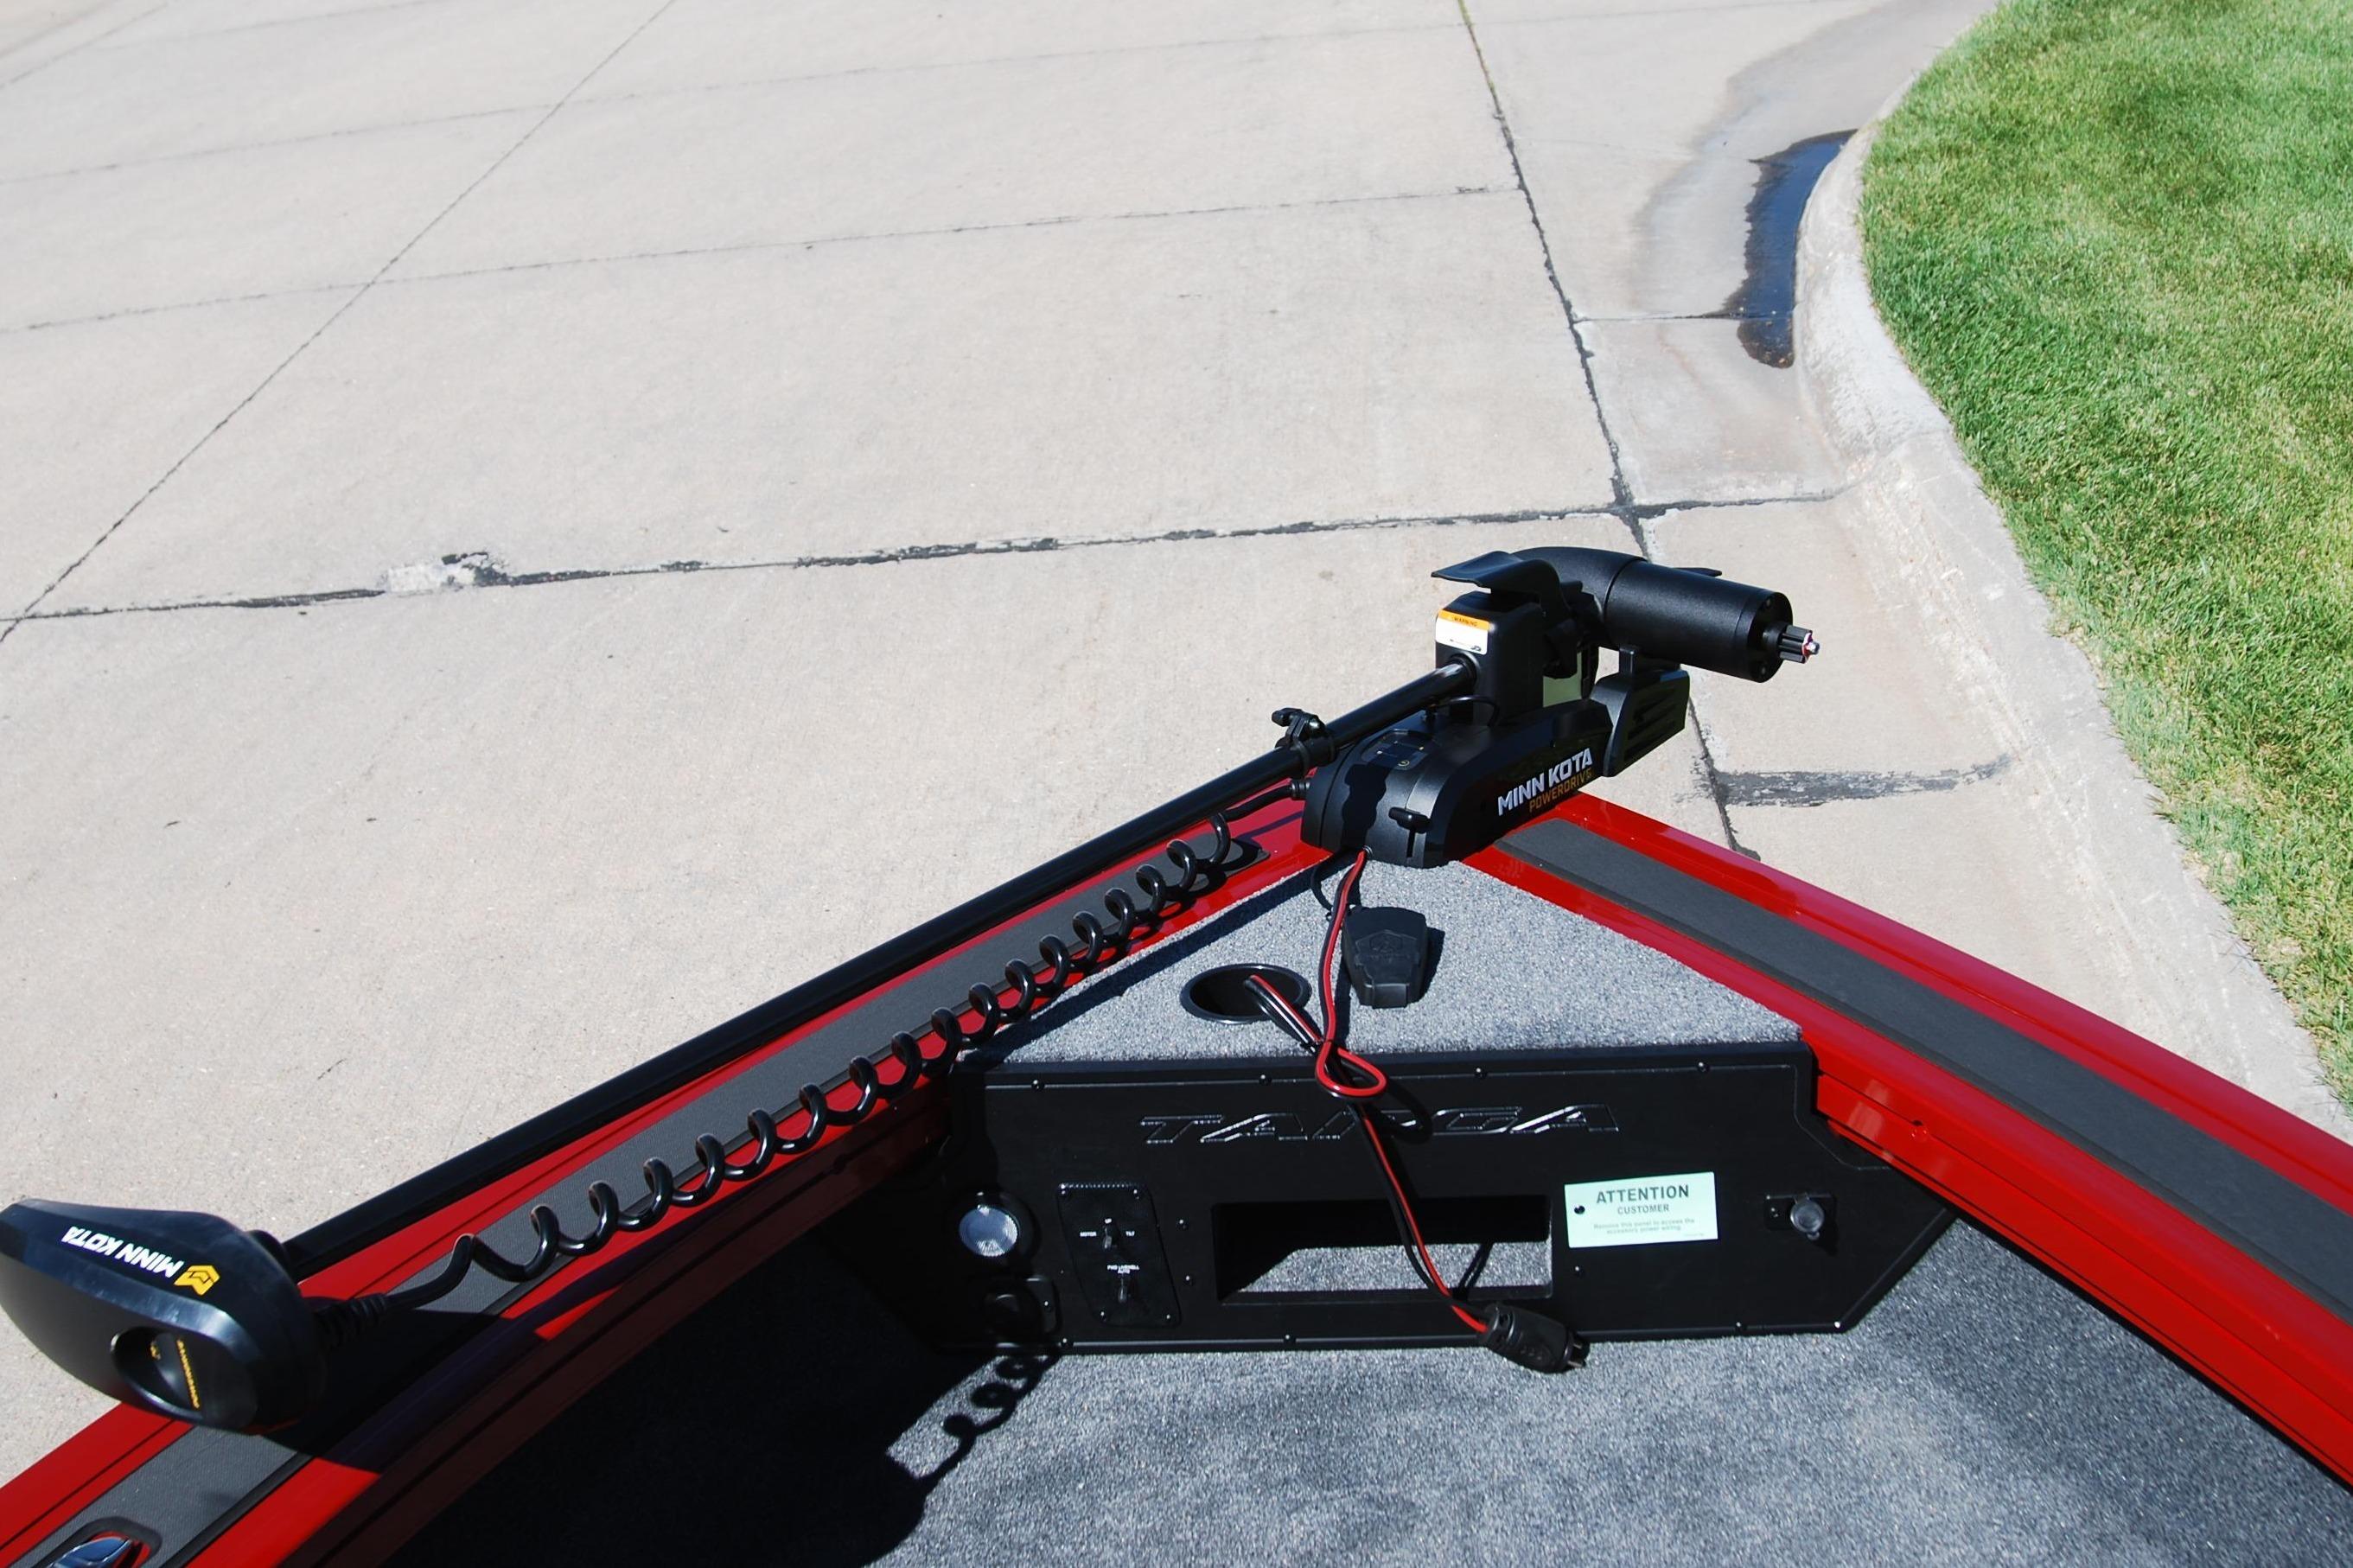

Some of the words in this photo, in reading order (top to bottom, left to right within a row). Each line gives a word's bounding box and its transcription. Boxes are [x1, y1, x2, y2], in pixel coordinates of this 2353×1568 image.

[1497, 772, 1545, 816] MINN
[1548, 748, 1593, 787] KOTA
[1529, 767, 1593, 813] POWERDRIVE
[1596, 1184, 1690, 1204] ATTENTION
[1617, 1203, 1670, 1214] CUSTOMER
[61, 1226, 124, 1256] KOTA
[114, 1242, 185, 1278] MINN
